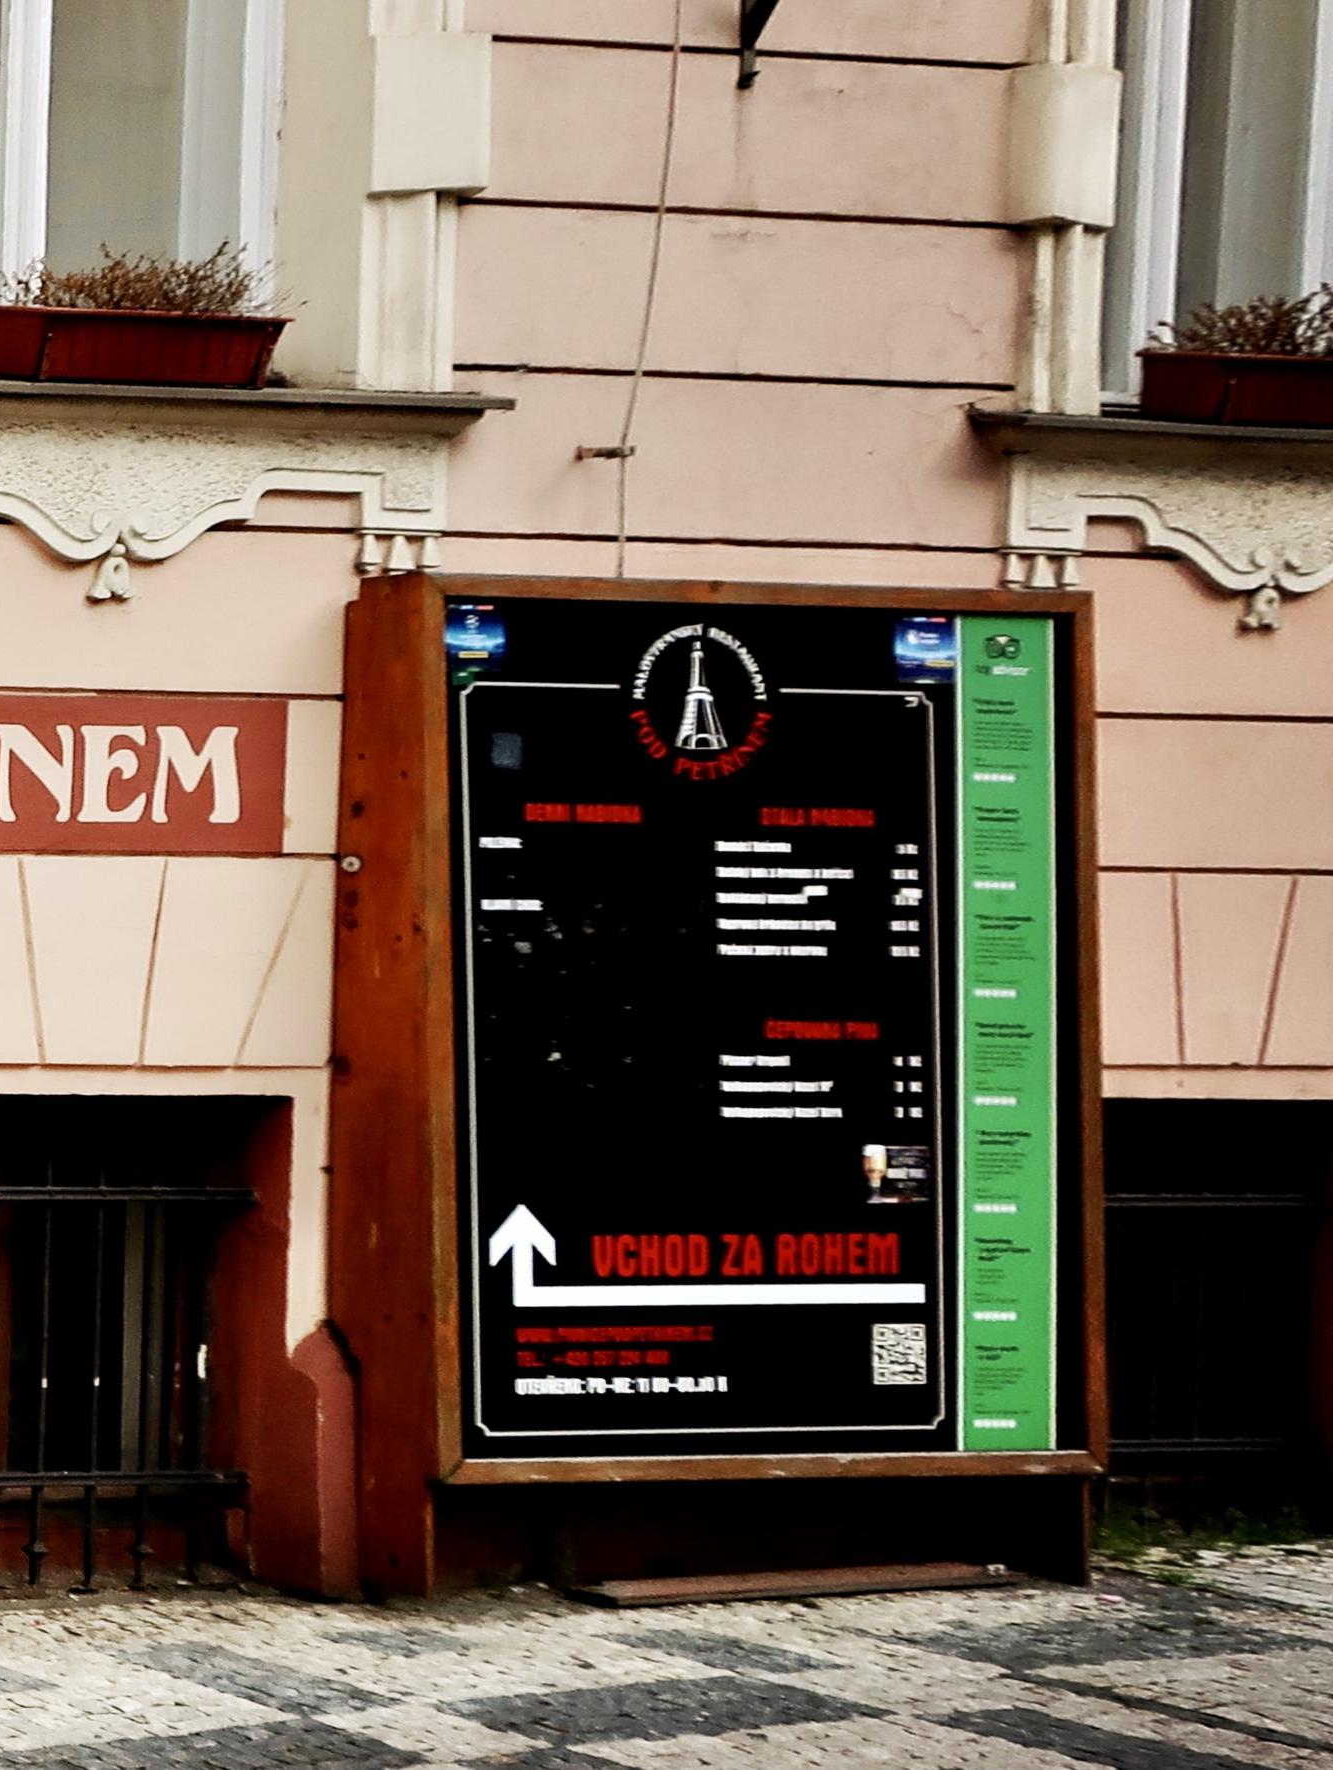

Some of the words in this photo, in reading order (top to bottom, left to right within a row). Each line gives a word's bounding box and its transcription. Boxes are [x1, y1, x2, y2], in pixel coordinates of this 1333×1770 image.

[591, 1234, 709, 1277] VCHOD
[721, 1234, 764, 1277] ZA
[775, 1232, 900, 1276] ROHEM
